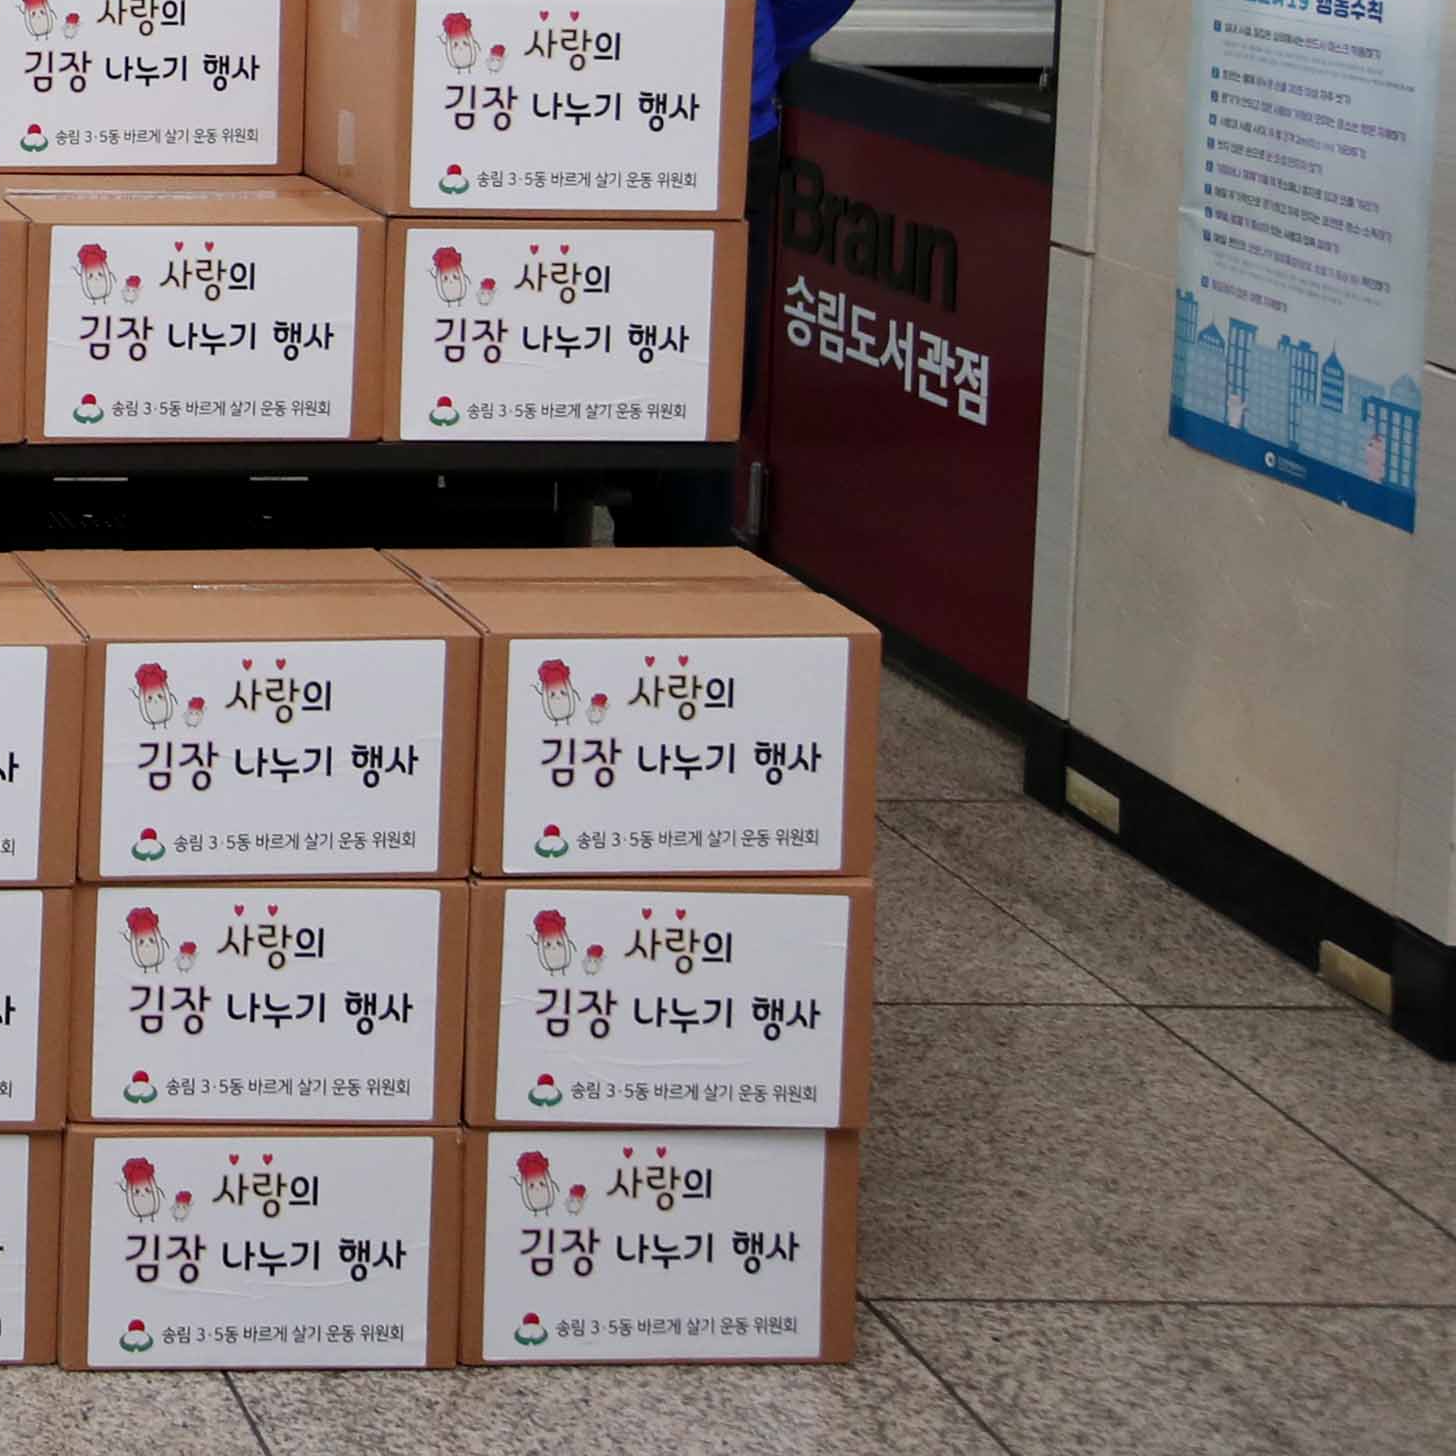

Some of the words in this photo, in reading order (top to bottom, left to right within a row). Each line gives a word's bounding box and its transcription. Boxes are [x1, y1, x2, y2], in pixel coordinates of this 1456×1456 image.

[524, 28, 621, 71] 사랑의
[445, 85, 518, 131] 김장
[533, 92, 621, 126] 나누기
[638, 91, 700, 132] 행사
[476, 170, 503, 187] 송림
[550, 171, 591, 187] 바르게
[594, 171, 621, 188] 살기
[625, 171, 653, 188] 운동
[656, 171, 696, 188] 위원회
[784, 274, 989, 427] 송림도서관점
[627, 675, 734, 721] 사랑의
[541, 737, 623, 788] 김장
[638, 743, 735, 781] 나누기
[754, 741, 822, 785] 행사
[576, 831, 605, 849] 송림
[658, 829, 702, 848] 바르게
[707, 829, 736, 847] 살기
[740, 829, 770, 847] 운동
[775, 828, 819, 846] 위원회
